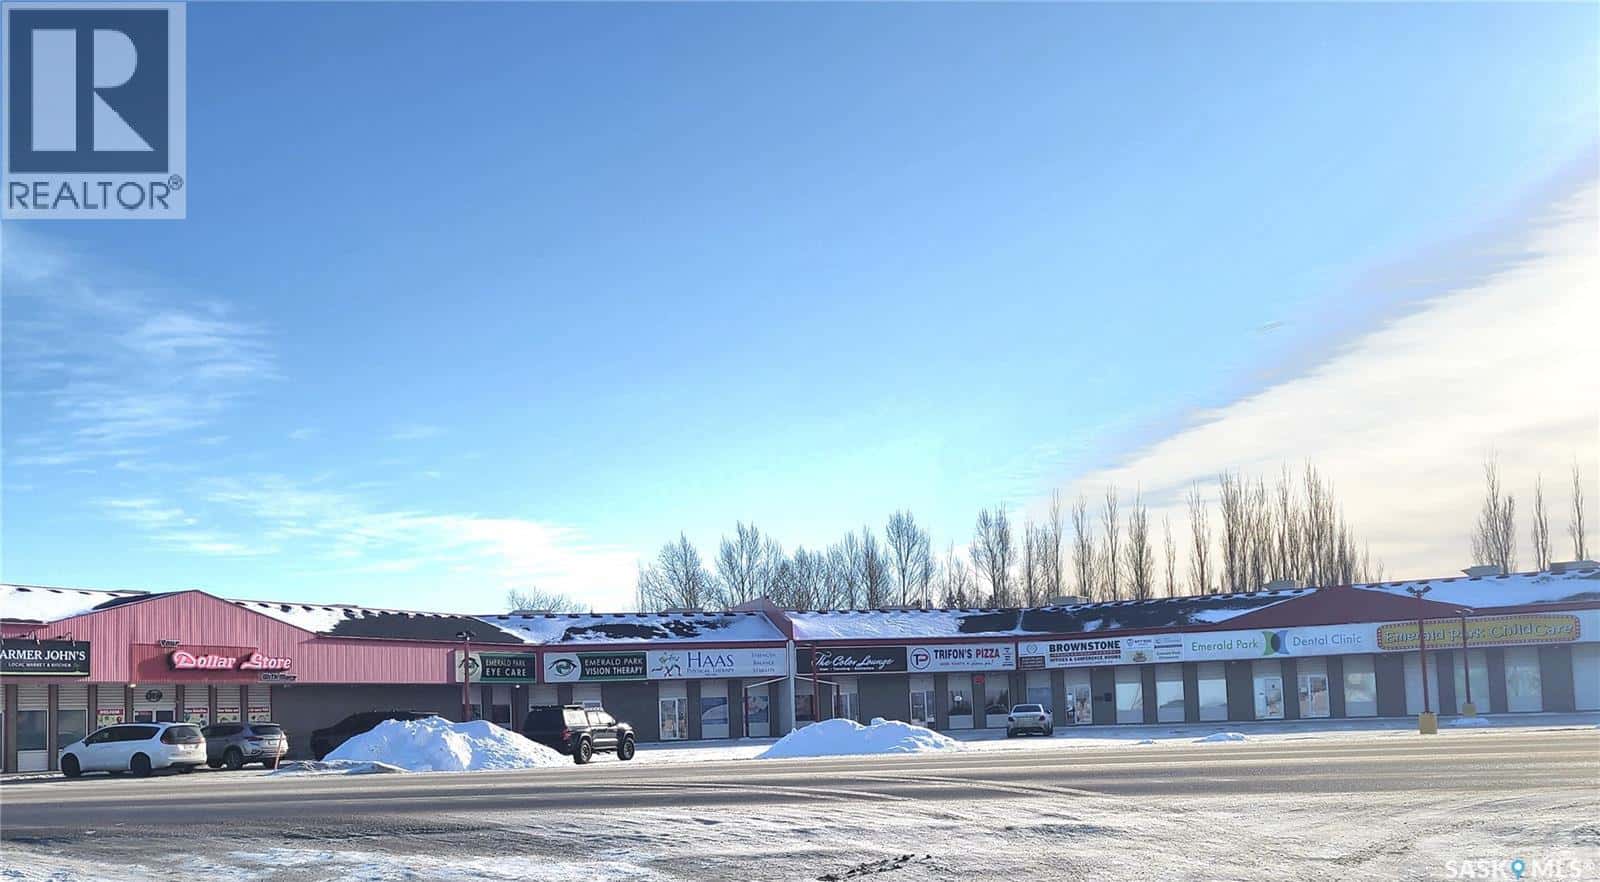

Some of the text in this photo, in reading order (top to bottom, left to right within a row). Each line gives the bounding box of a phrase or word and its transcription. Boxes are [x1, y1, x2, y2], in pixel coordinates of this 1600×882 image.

[1191, 639, 1233, 652] Emerald
[1236, 639, 1258, 650] Park
[1292, 632, 1362, 647] Dental Clinic
[1048, 640, 1121, 653] BROWNSTONE
[0, 649, 86, 661] ARMER JOHN'S
[933, 648, 973, 660] TRIFON'S
[975, 647, 1000, 659] PIZZA
[173, 651, 292, 670] Dollar Store
[485, 658, 511, 667] EMERALD
[584, 657, 644, 666] EMERALD PARK
[832, 655, 857, 667] Color
[856, 654, 895, 670] Lounge
[485, 667, 528, 677] EYE CARE
[584, 665, 644, 676] VISION THERAPY
